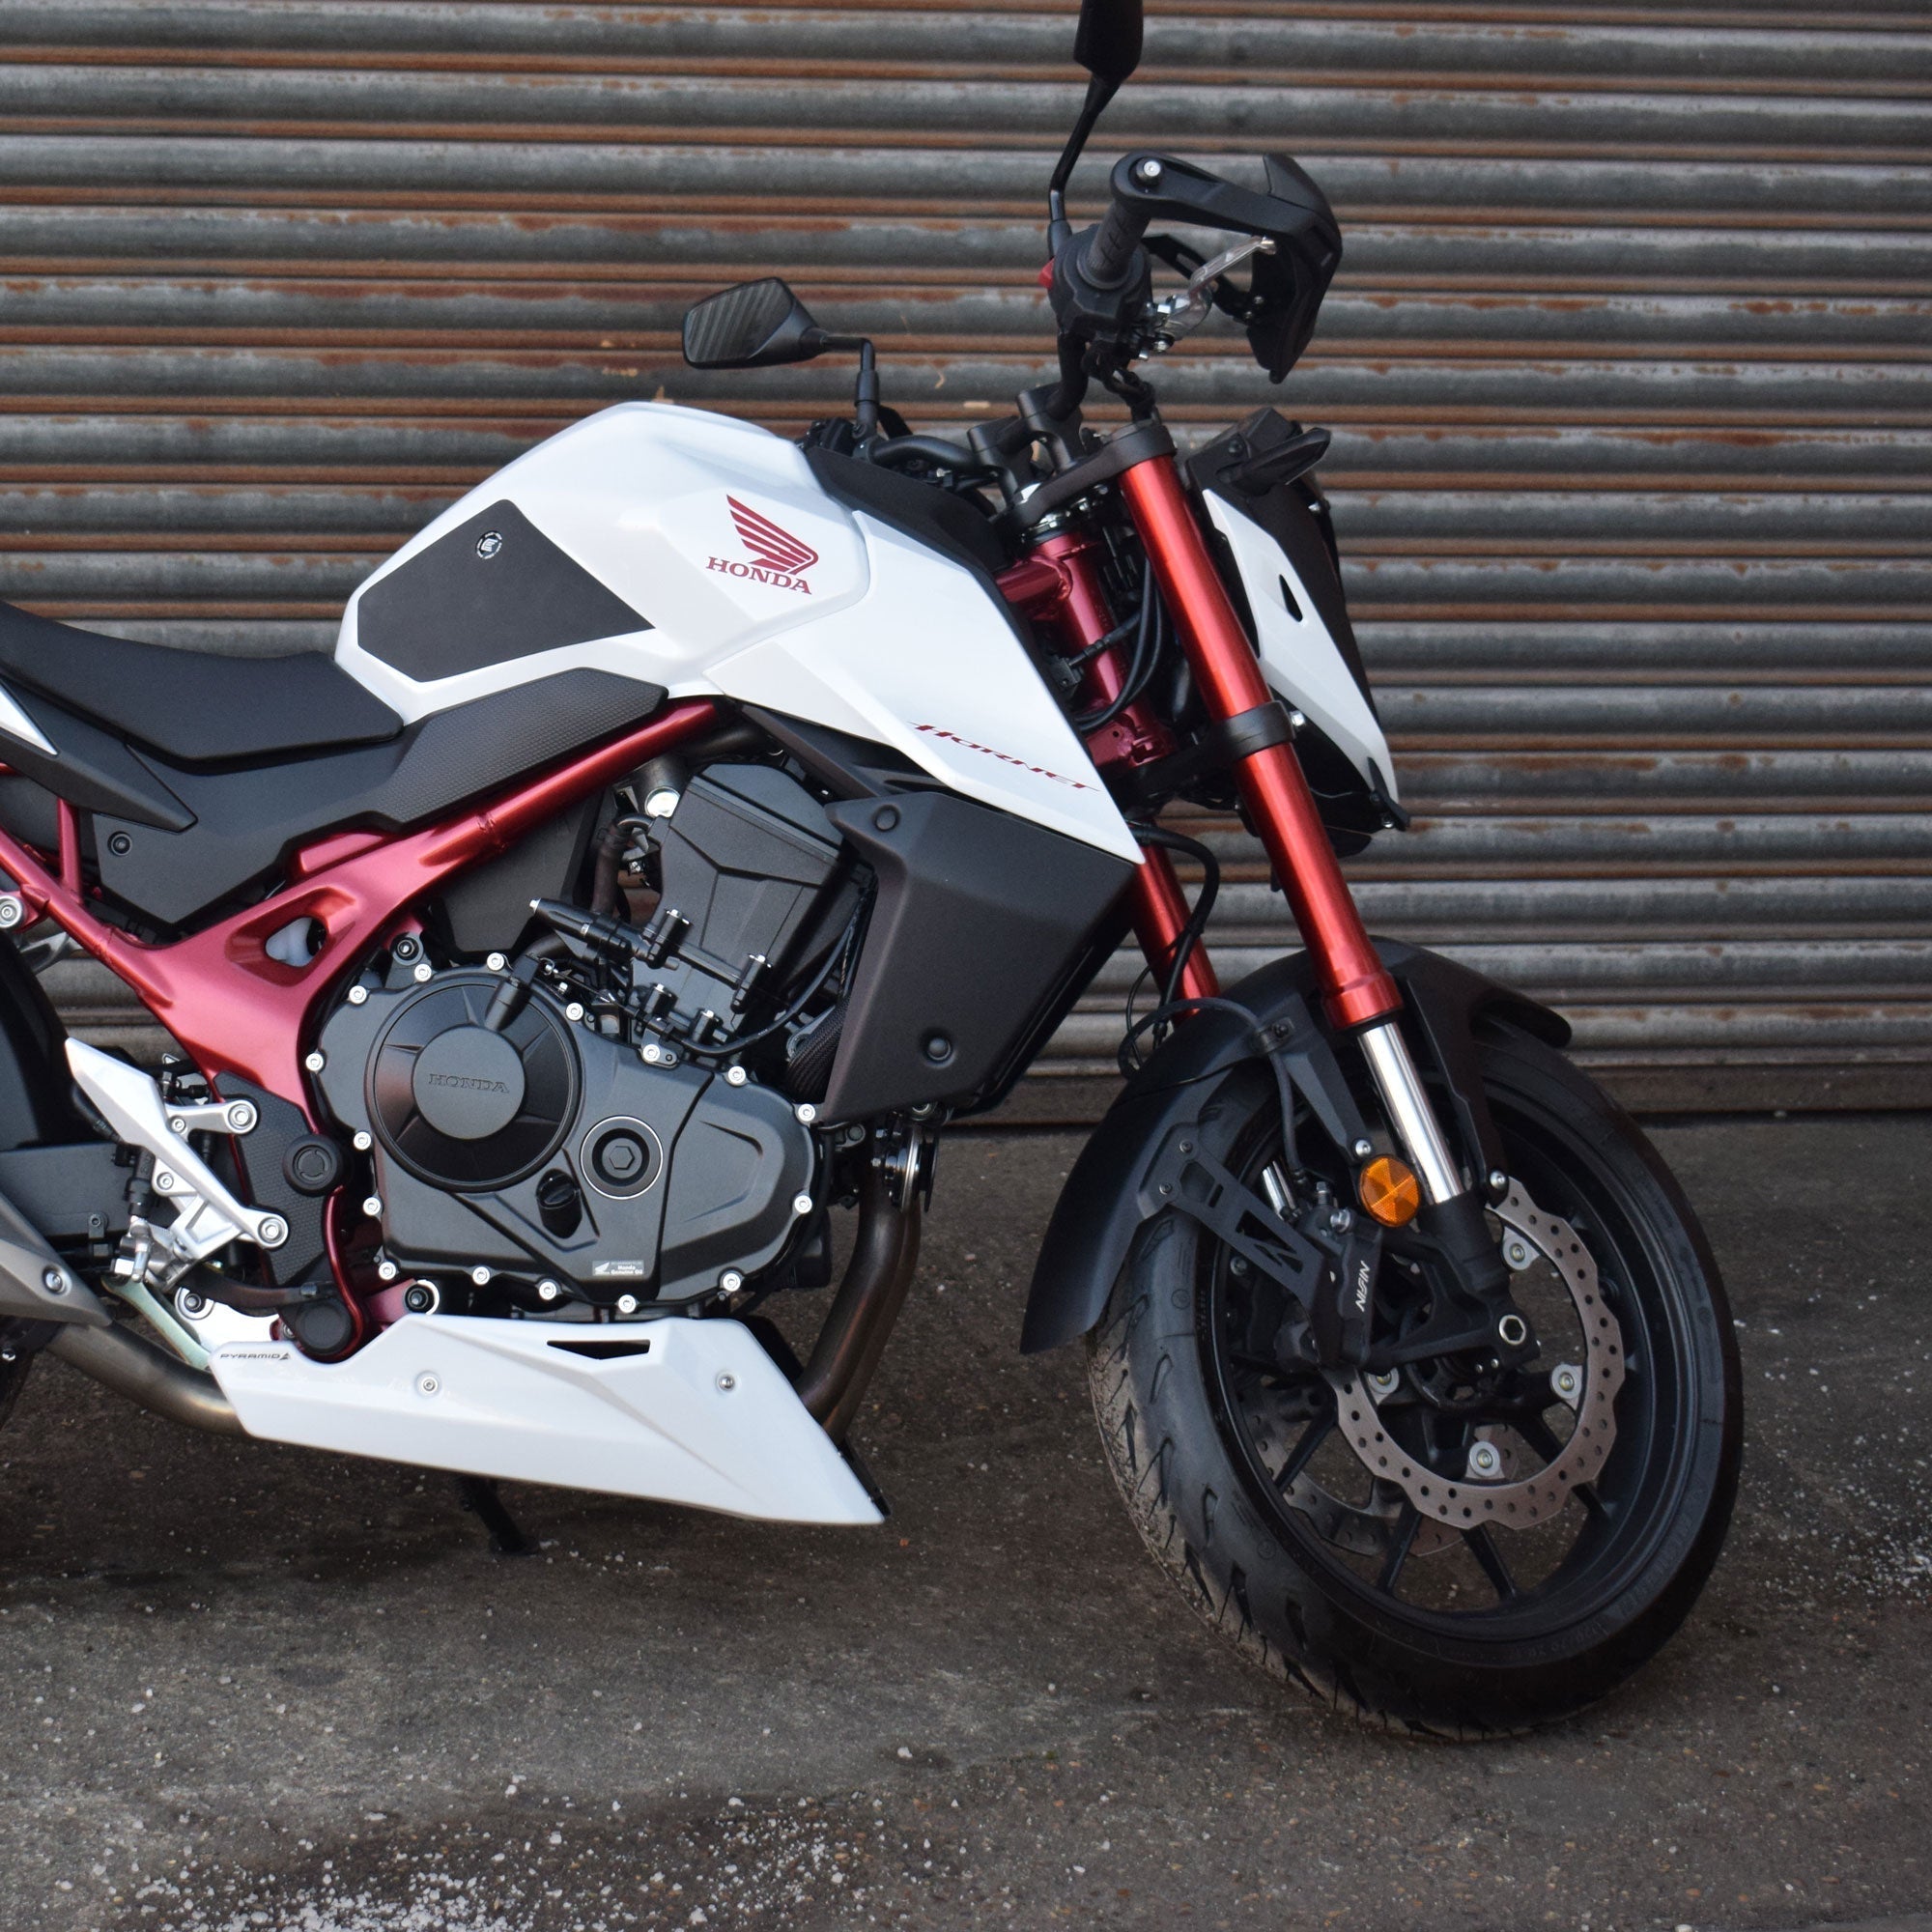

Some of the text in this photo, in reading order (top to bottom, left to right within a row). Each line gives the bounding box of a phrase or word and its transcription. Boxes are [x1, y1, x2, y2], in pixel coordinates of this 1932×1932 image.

[706, 556, 812, 595] HONDA
[908, 722, 1100, 792] HORNET
[428, 1073, 510, 1094] HONDA
[1355, 1260, 1370, 1312] NISSIN
